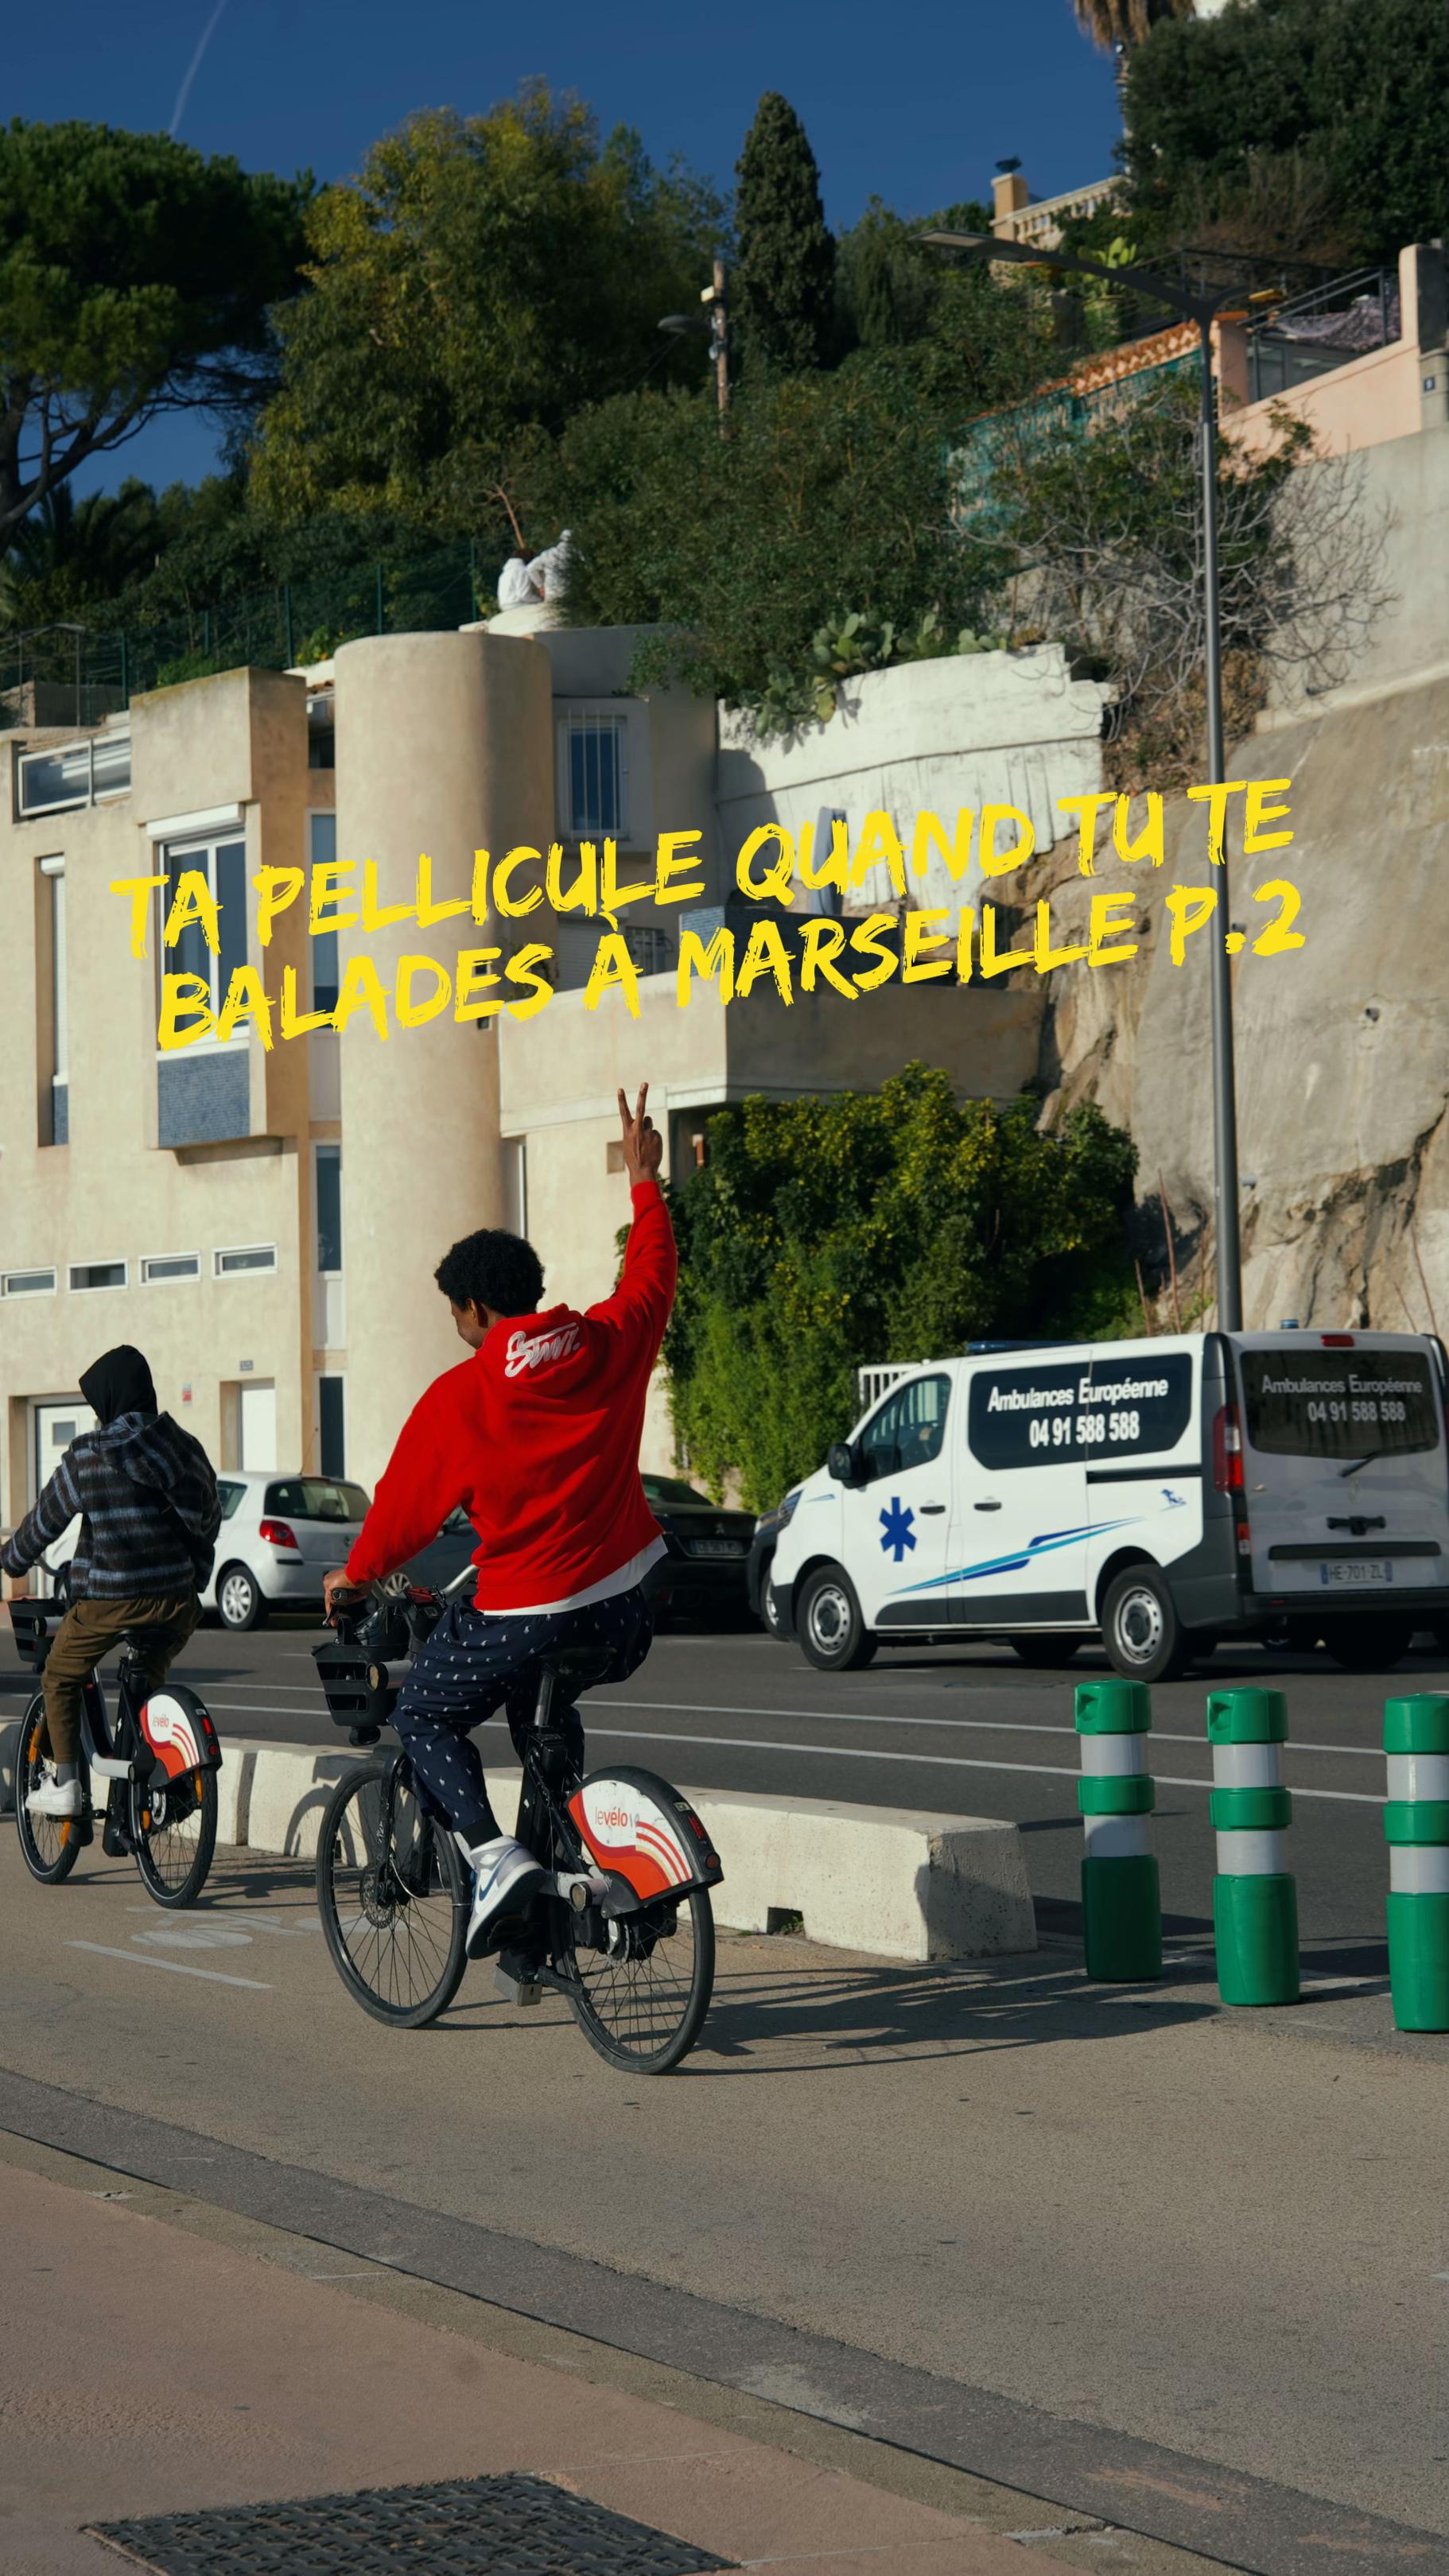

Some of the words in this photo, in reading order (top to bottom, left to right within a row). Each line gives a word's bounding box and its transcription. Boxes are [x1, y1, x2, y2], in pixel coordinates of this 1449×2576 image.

[987, 1386, 1074, 1412] Ambulances
[1078, 1377, 1169, 1406] Européenne
[1261, 1374, 1346, 1394] Ambulances
[1348, 1374, 1423, 1396] Européenne
[1307, 1401, 1327, 1422] 04
[1329, 1401, 1347, 1422] 91
[1351, 1401, 1377, 1422] 588
[1380, 1401, 1406, 1422] 588
[1029, 1418, 1049, 1448] 04
[1052, 1416, 1071, 1445] 91
[1075, 1414, 1105, 1444] 588
[1109, 1410, 1140, 1441] 588
